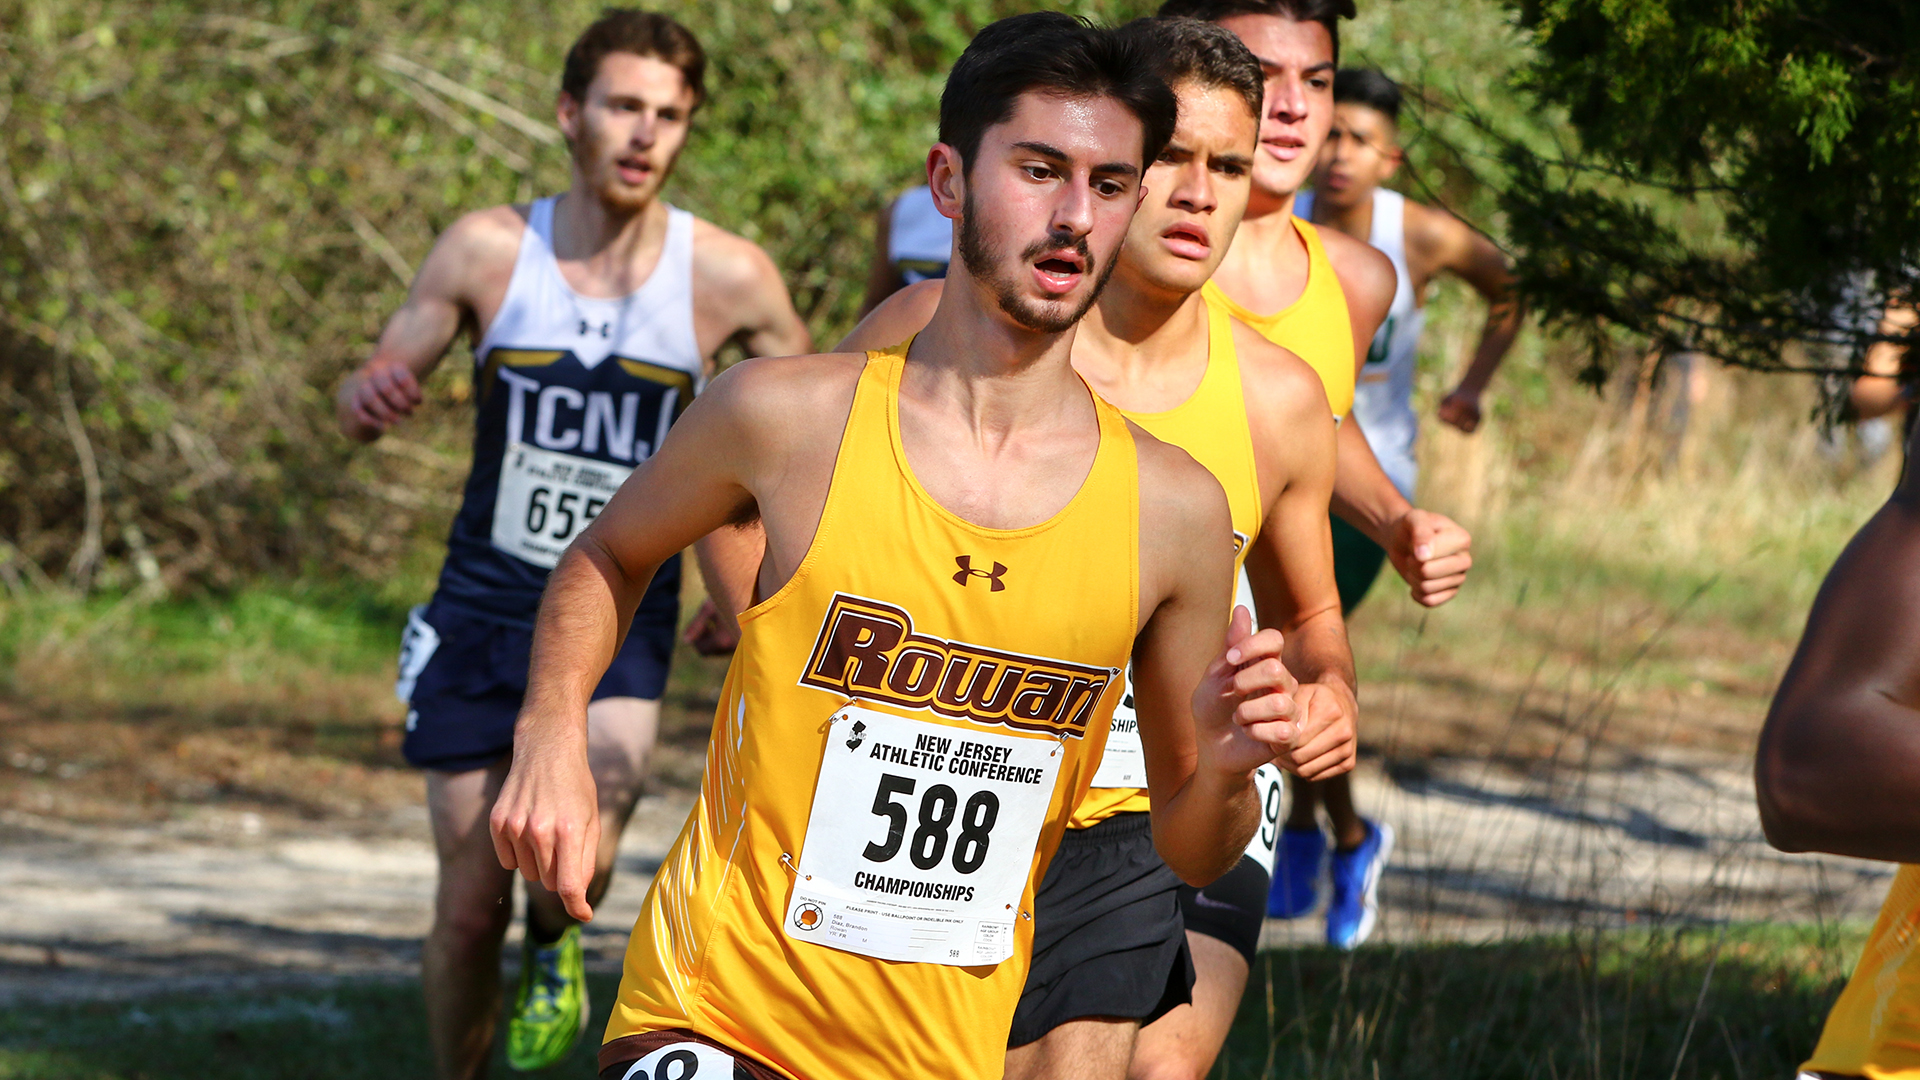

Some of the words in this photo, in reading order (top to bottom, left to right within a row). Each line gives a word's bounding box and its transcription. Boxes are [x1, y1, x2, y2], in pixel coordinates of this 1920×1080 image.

[803, 597, 1109, 735] Rowan
[869, 743, 945, 771] ATHLETIC
[948, 757, 1044, 785] CONFERENCE
[915, 733, 952, 755] NEW
[954, 741, 1013, 764] JERSEY
[862, 773, 1000, 875] 588
[854, 871, 975, 902] CHAMPIONSHIPS
[845, 922, 868, 932] Brandon
[846, 905, 864, 913] PLEASE
[891, 913, 916, 921] BALLPOINT
